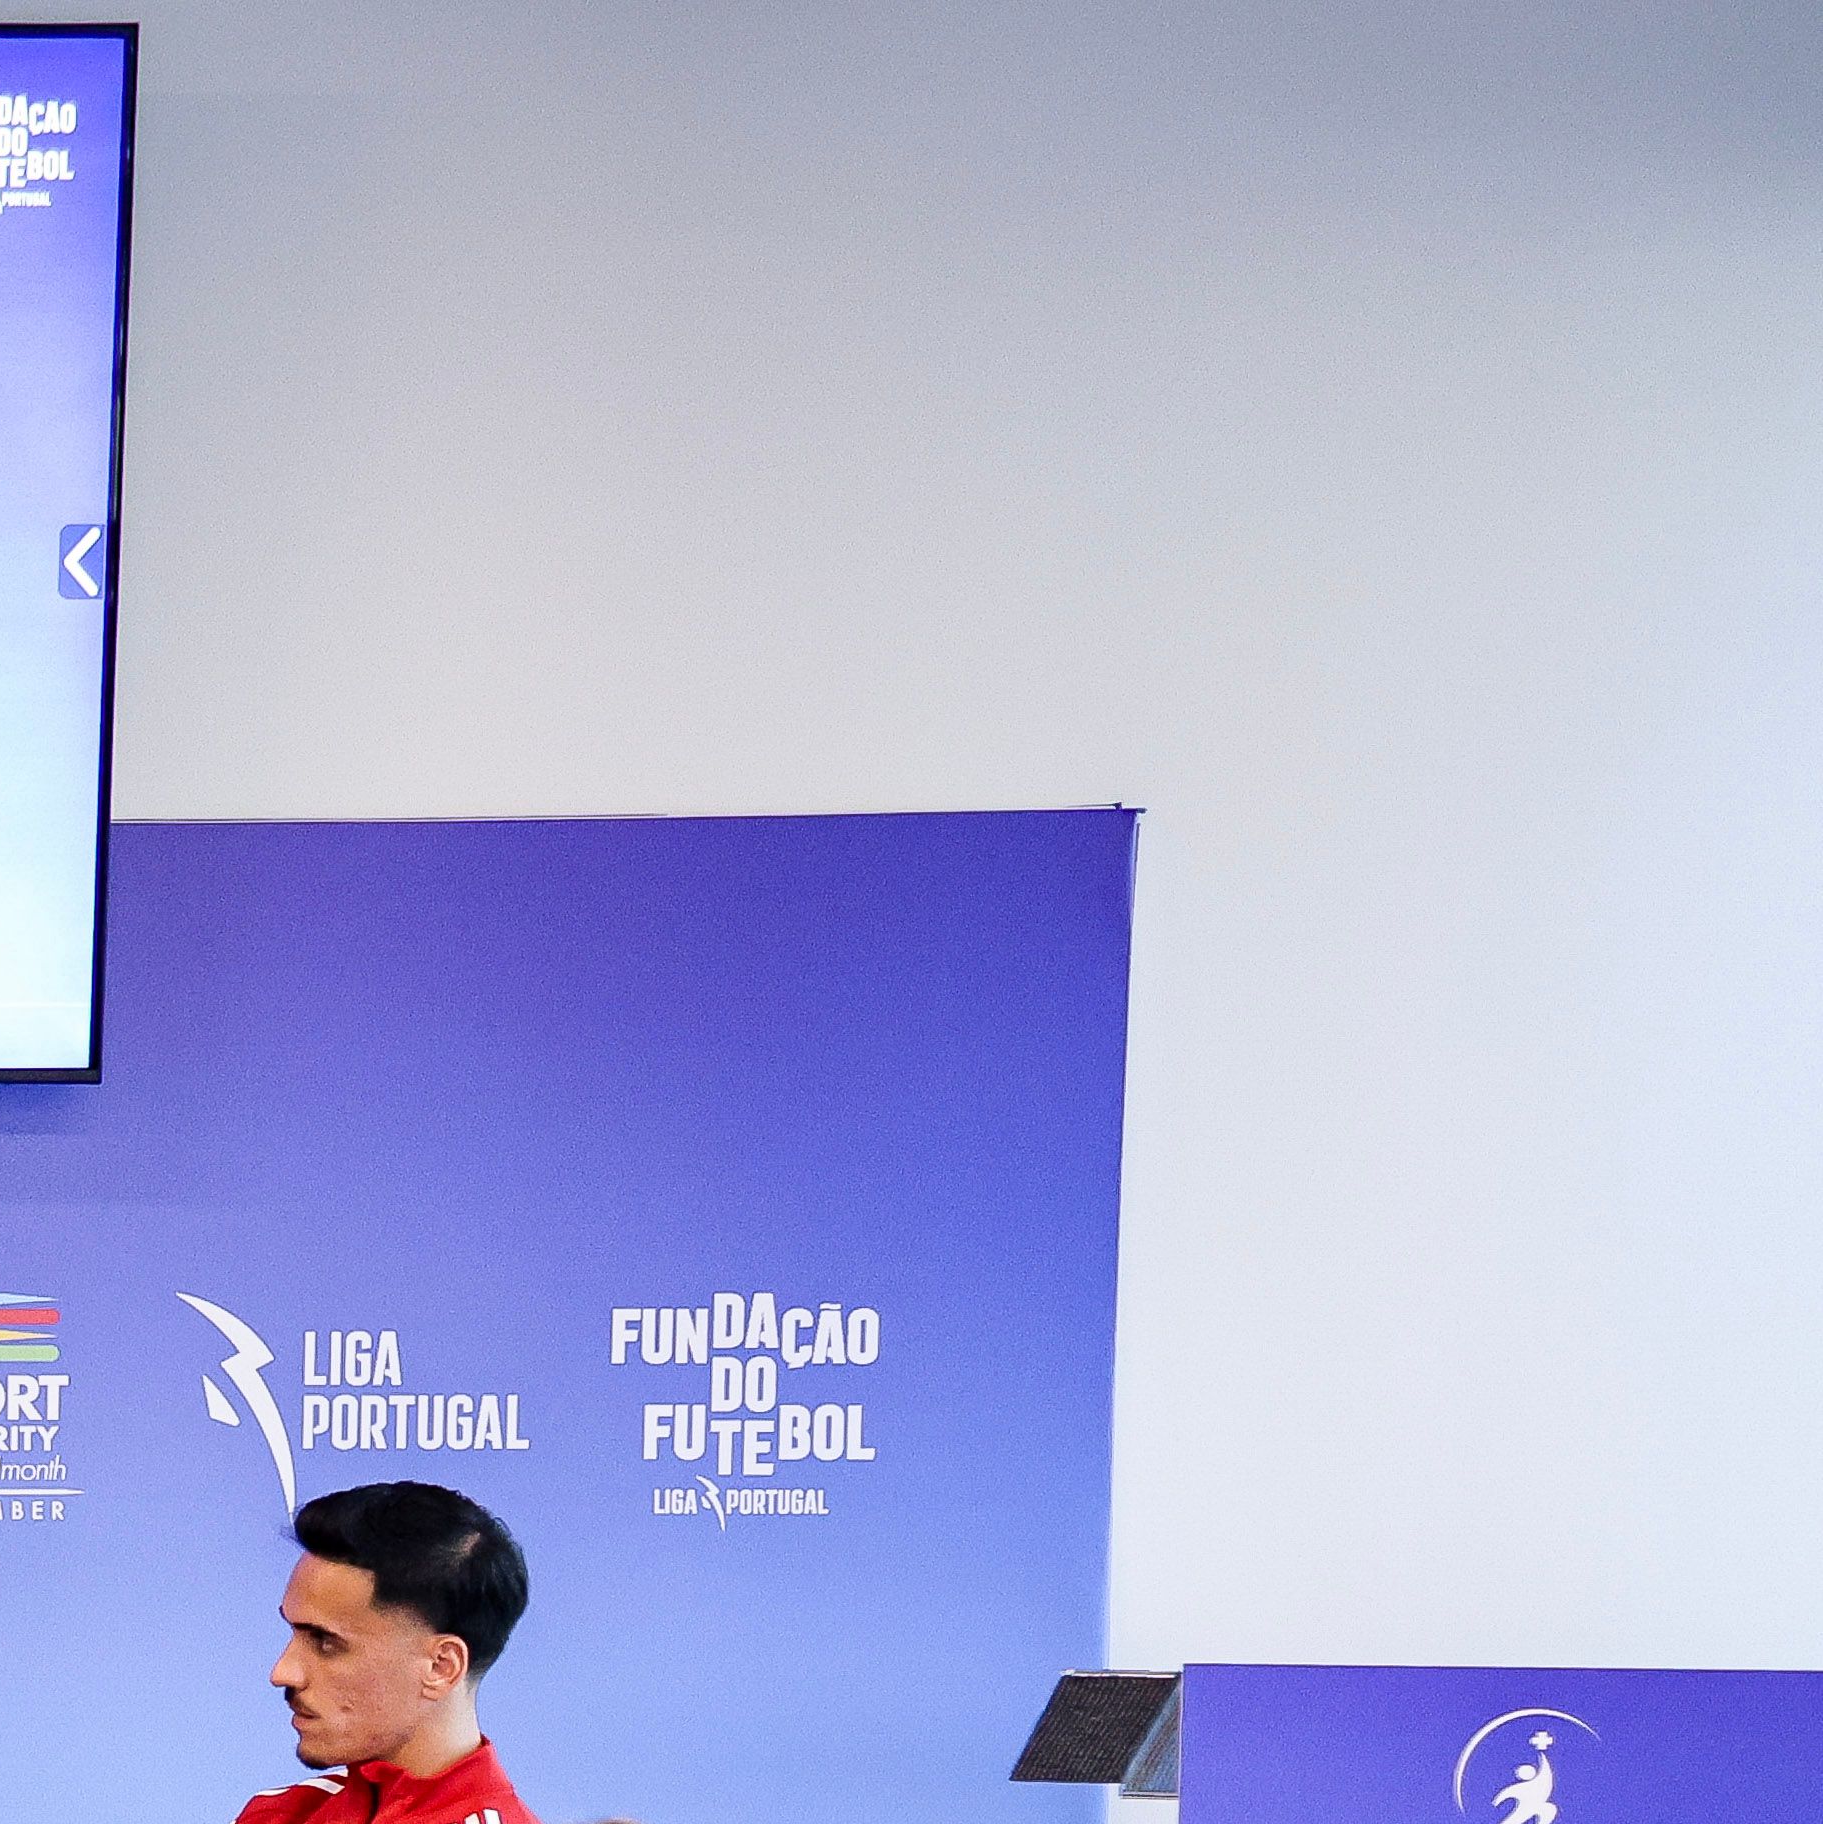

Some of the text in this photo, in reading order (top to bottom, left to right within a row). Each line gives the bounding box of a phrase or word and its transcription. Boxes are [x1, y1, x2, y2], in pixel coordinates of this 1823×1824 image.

[303, 1330, 402, 1386] LIGA
[610, 1292, 880, 1368] FUNDAÇÃO
[710, 1355, 778, 1413] DO
[302, 1395, 531, 1450] PORTUGAL
[642, 1402, 877, 1476] FUTEBOL
[653, 1488, 829, 1515] LIGA PORTUGAL
